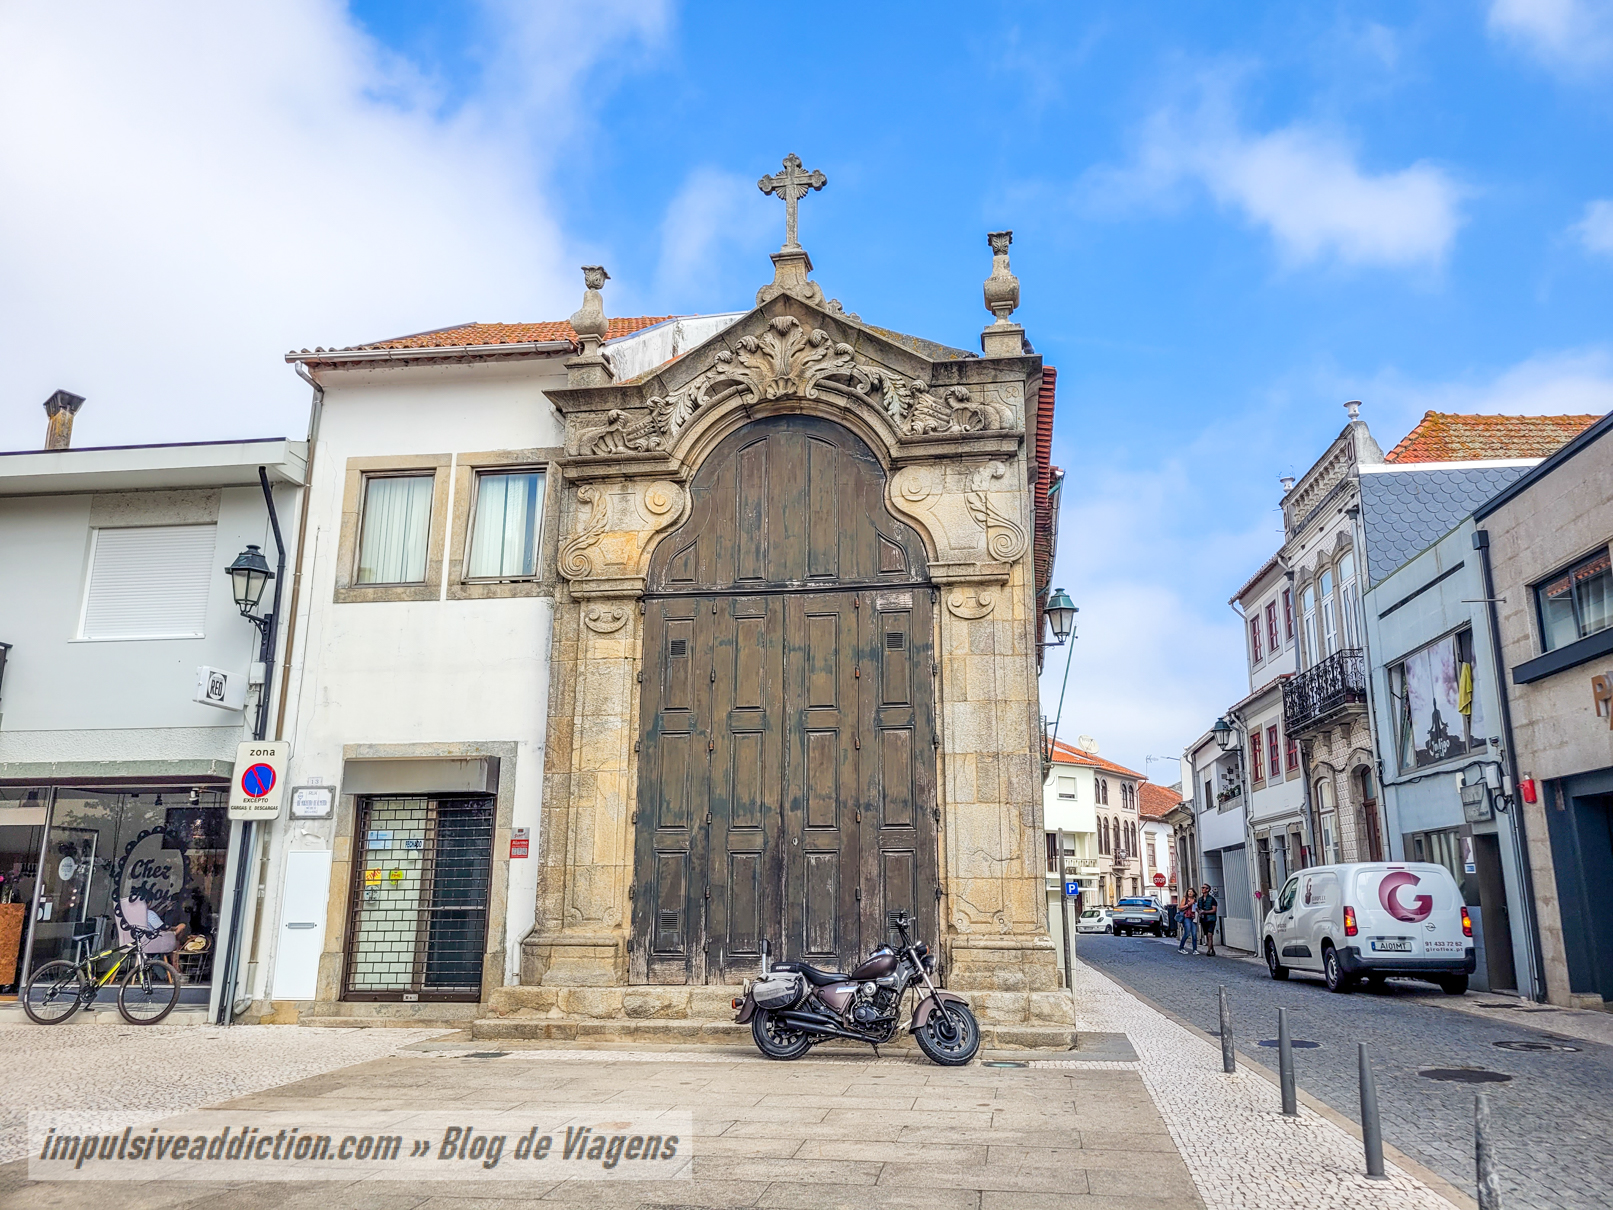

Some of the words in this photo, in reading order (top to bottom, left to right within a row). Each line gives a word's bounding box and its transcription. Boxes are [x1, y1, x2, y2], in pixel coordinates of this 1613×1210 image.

[249, 748, 276, 757] zona
[131, 859, 172, 880] Chez
[1069, 884, 1076, 893] P
[1378, 871, 1433, 923] G
